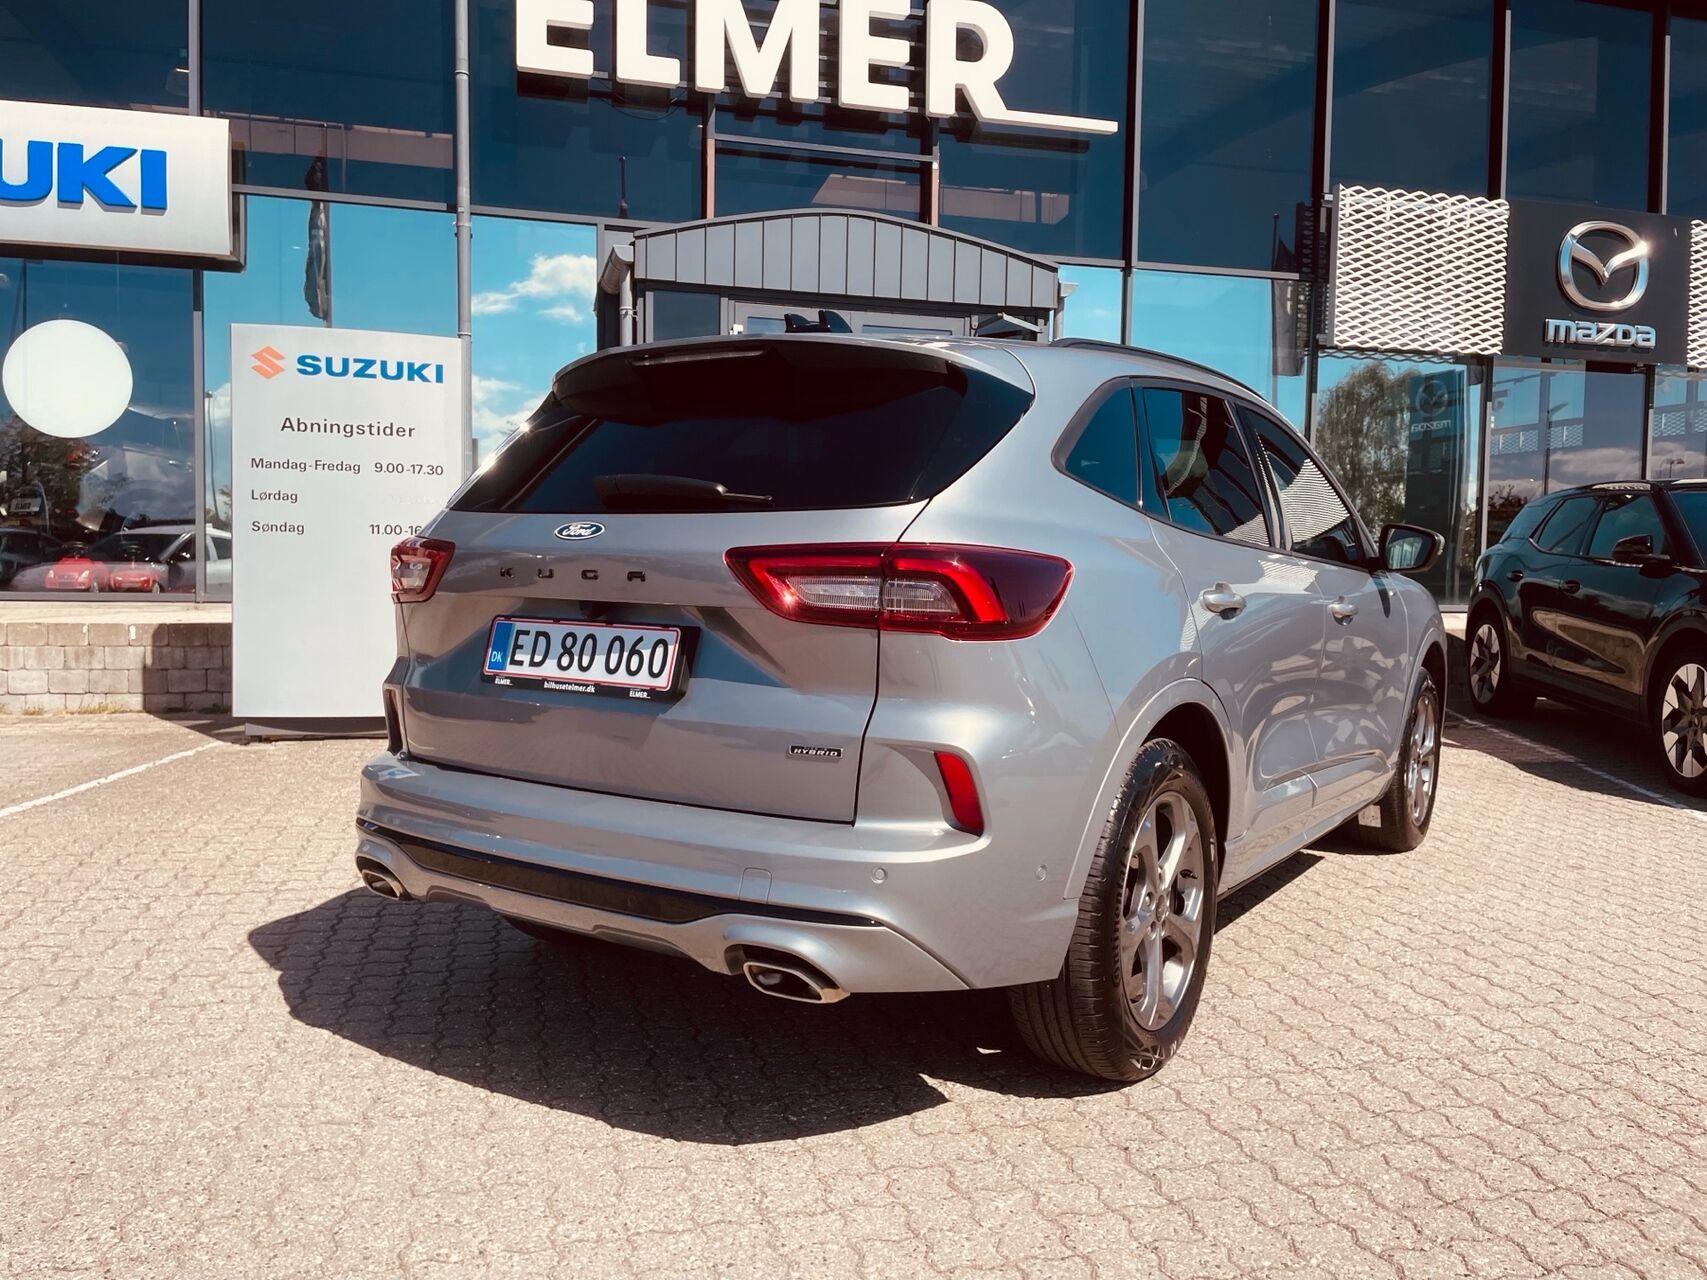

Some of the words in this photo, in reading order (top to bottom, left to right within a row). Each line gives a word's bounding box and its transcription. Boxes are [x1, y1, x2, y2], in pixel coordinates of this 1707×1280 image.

[515, 0, 1119, 134] ELMER
[0, 139, 167, 210] UKI
[1544, 318, 1656, 349] mazda
[296, 354, 444, 384] SUZUKI
[280, 417, 416, 438] Abningstider
[250, 489, 298, 503] Lørdag
[251, 520, 305, 535] Søndag
[562, 523, 596, 536] Ford
[500, 567, 646, 582] KUGA
[491, 652, 502, 663] DK
[509, 629, 551, 668] ED
[557, 631, 598, 673] 80
[604, 635, 669, 679] 060
[544, 680, 596, 693] bilhusetelmer.dk
[794, 748, 838, 756] HYBRID
